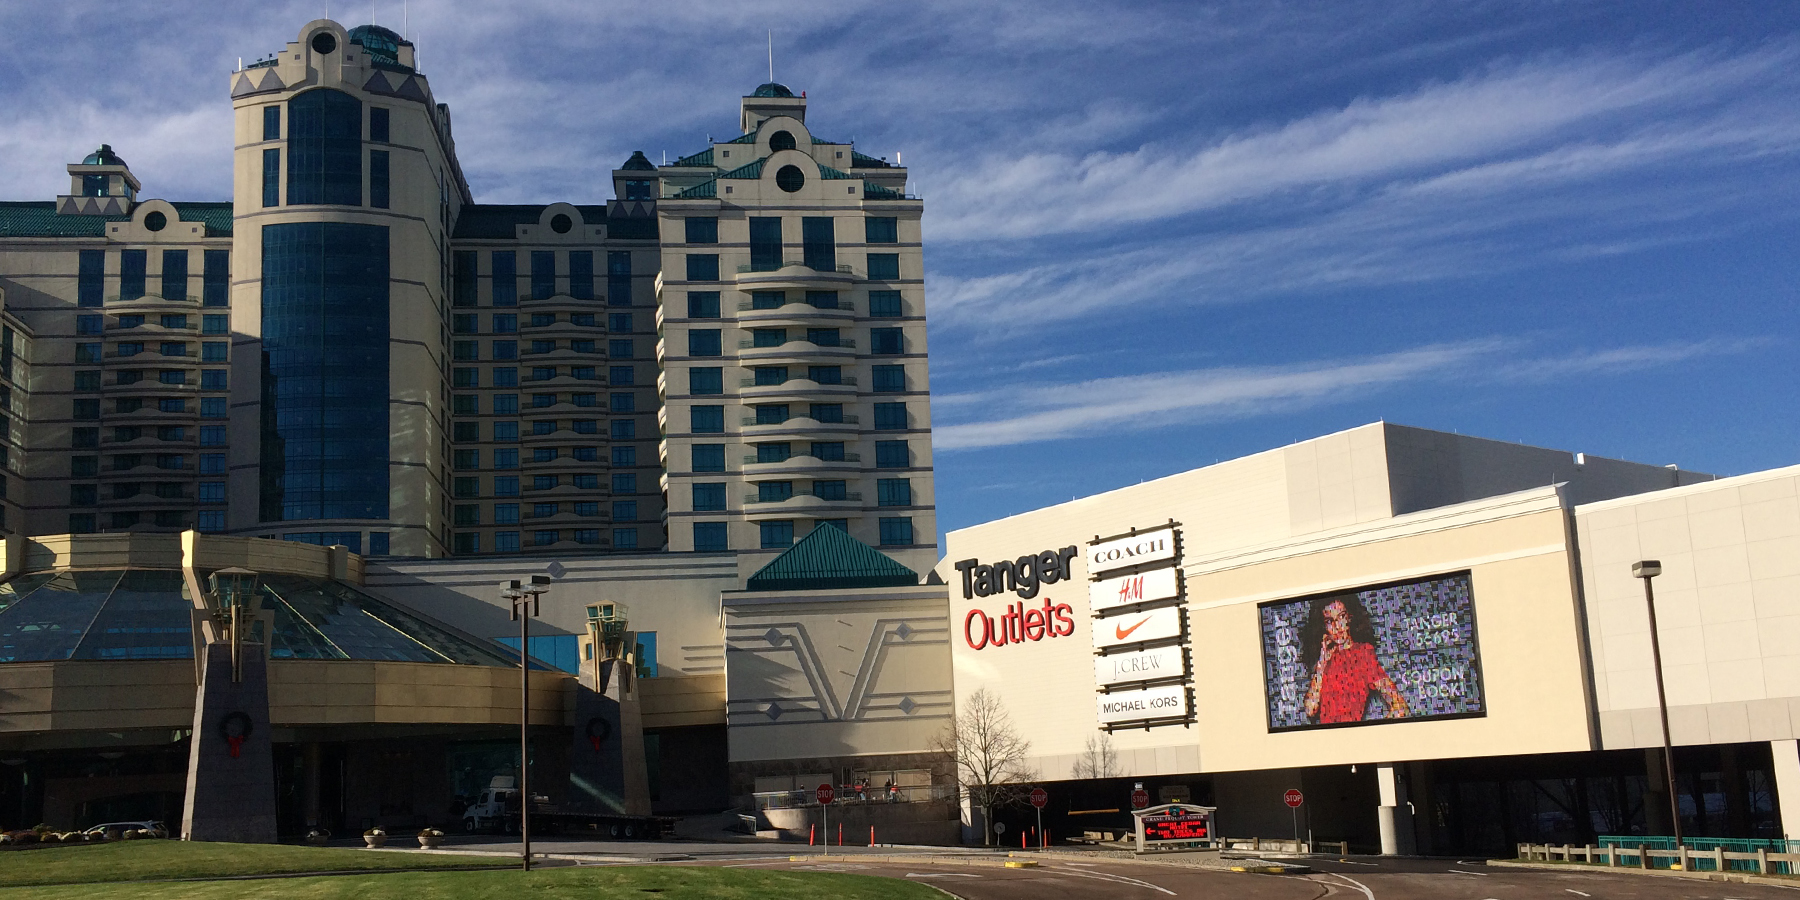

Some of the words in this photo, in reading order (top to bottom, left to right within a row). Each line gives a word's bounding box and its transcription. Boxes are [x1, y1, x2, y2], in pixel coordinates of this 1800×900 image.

[1094, 539, 1165, 564] COACH
[955, 544, 1078, 600] Tanger
[1118, 575, 1144, 603] H&M
[964, 597, 1075, 650] Outlets
[1403, 612, 1459, 631] TANGER
[1113, 653, 1163, 681] J.CREW
[1401, 667, 1465, 687] COUPON
[1103, 700, 1146, 714] MICHAEL
[1149, 696, 1178, 709] KORS
[817, 790, 834, 799] STOP
[1031, 794, 1047, 803] STOP
[1132, 795, 1149, 803] STOP
